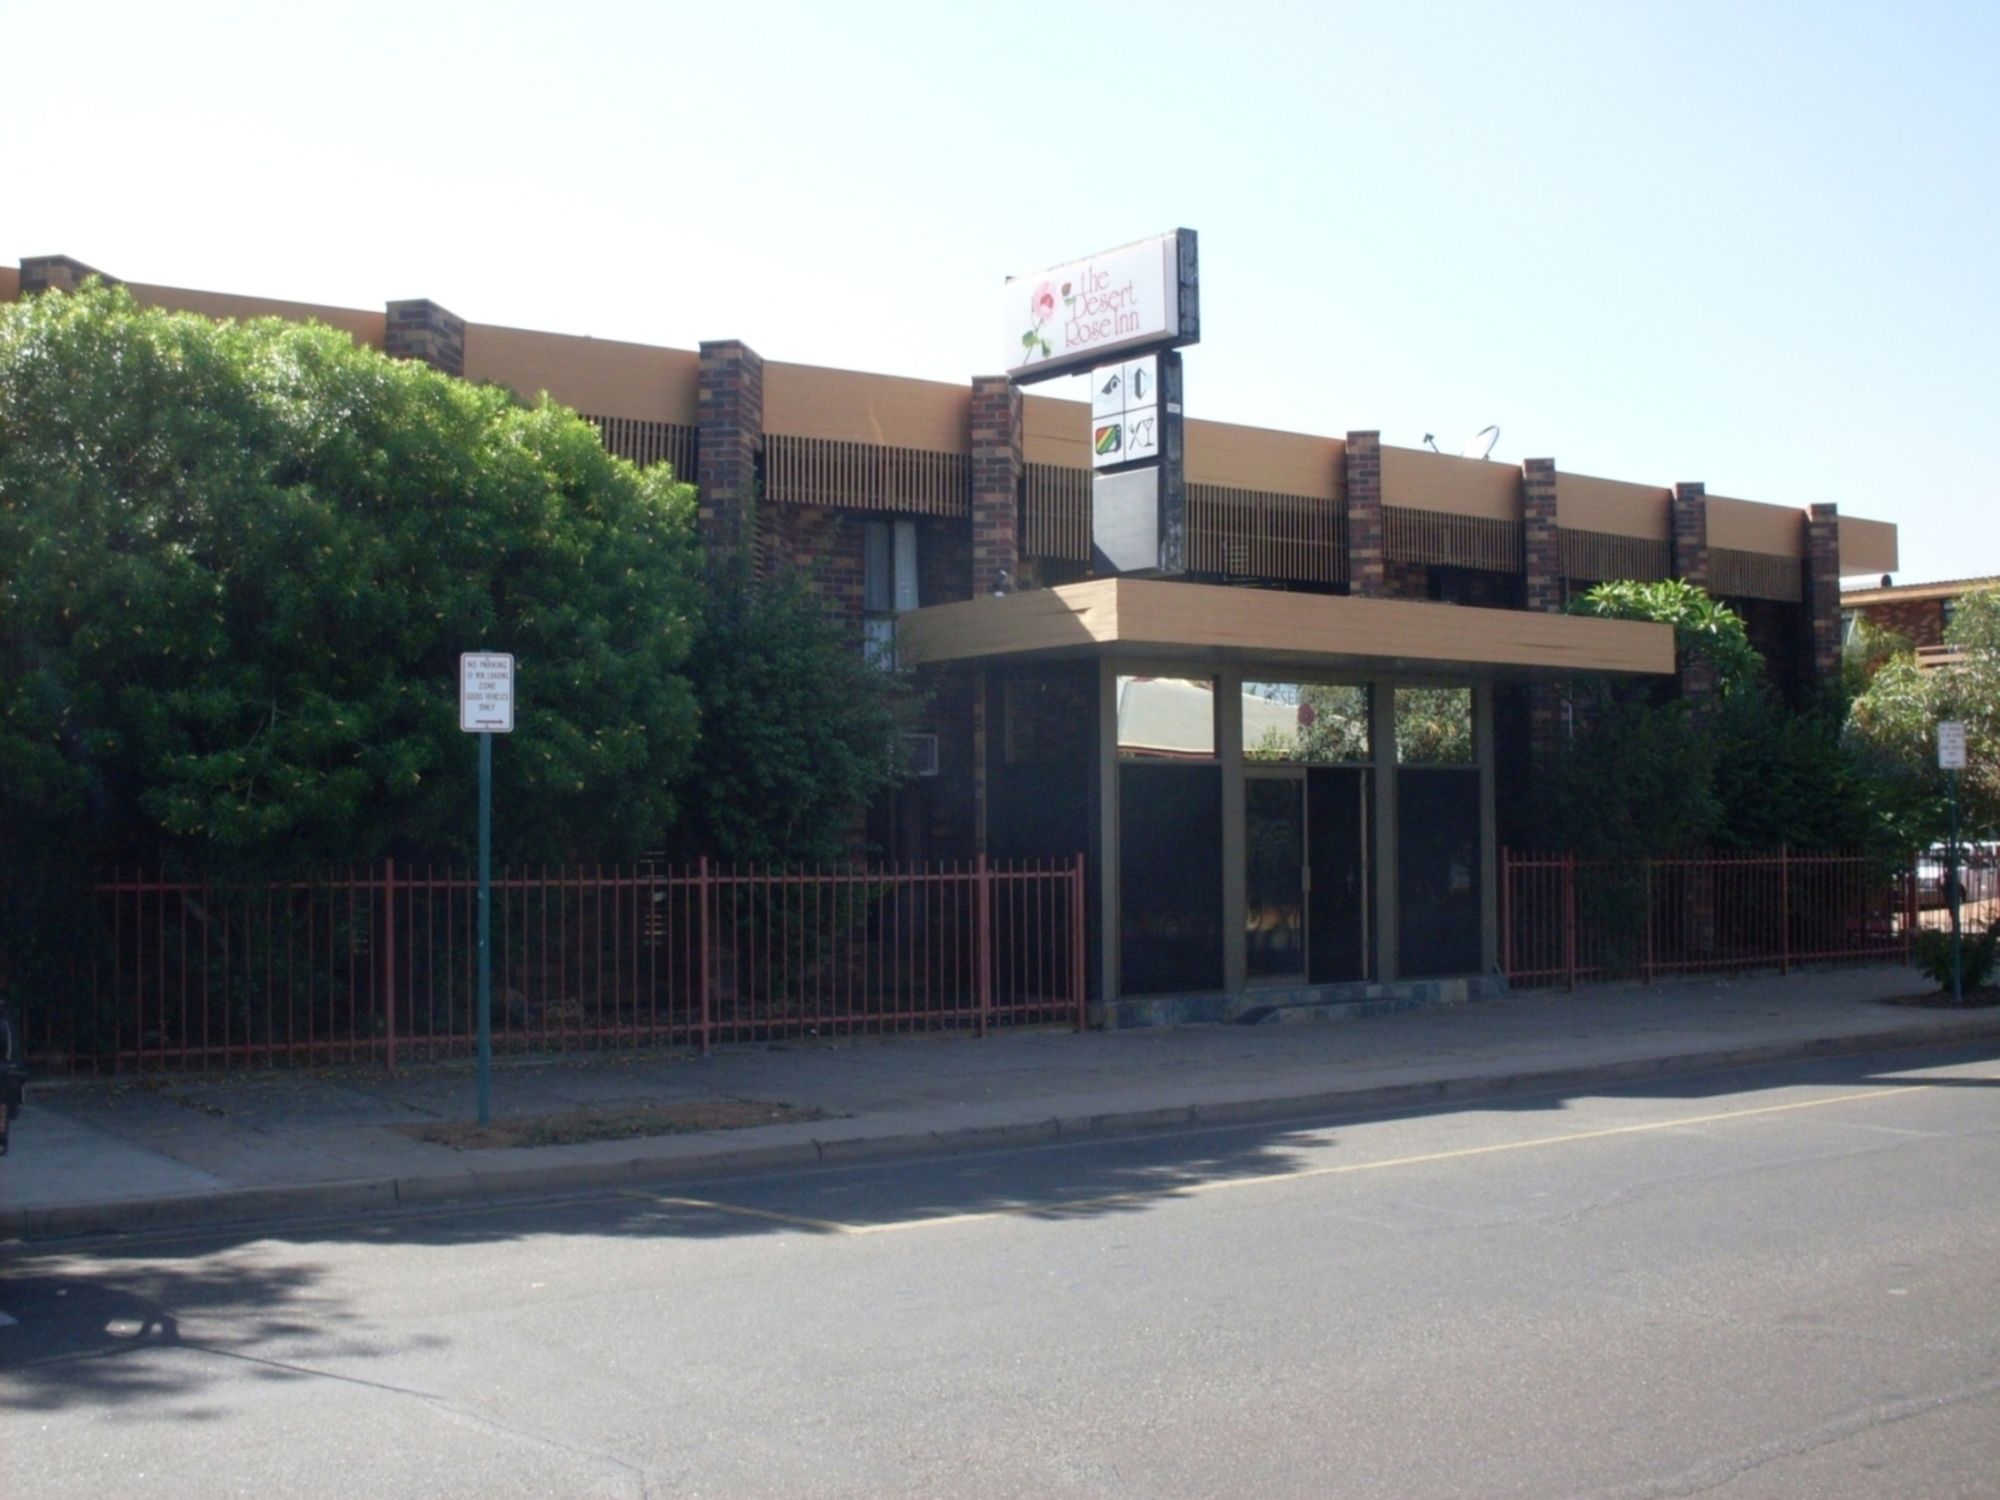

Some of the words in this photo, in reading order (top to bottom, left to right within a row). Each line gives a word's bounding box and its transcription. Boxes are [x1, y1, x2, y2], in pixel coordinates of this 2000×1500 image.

[1081, 264, 1110, 294] the
[1072, 279, 1137, 320] Desert
[1065, 319, 1112, 348] Rose
[1113, 308, 1141, 336] Inn
[467, 661, 477, 669] NO
[480, 661, 508, 669] PARKING
[487, 671, 509, 680] LOADING
[478, 682, 496, 690] ZONE
[479, 703, 495, 711] ONLY
